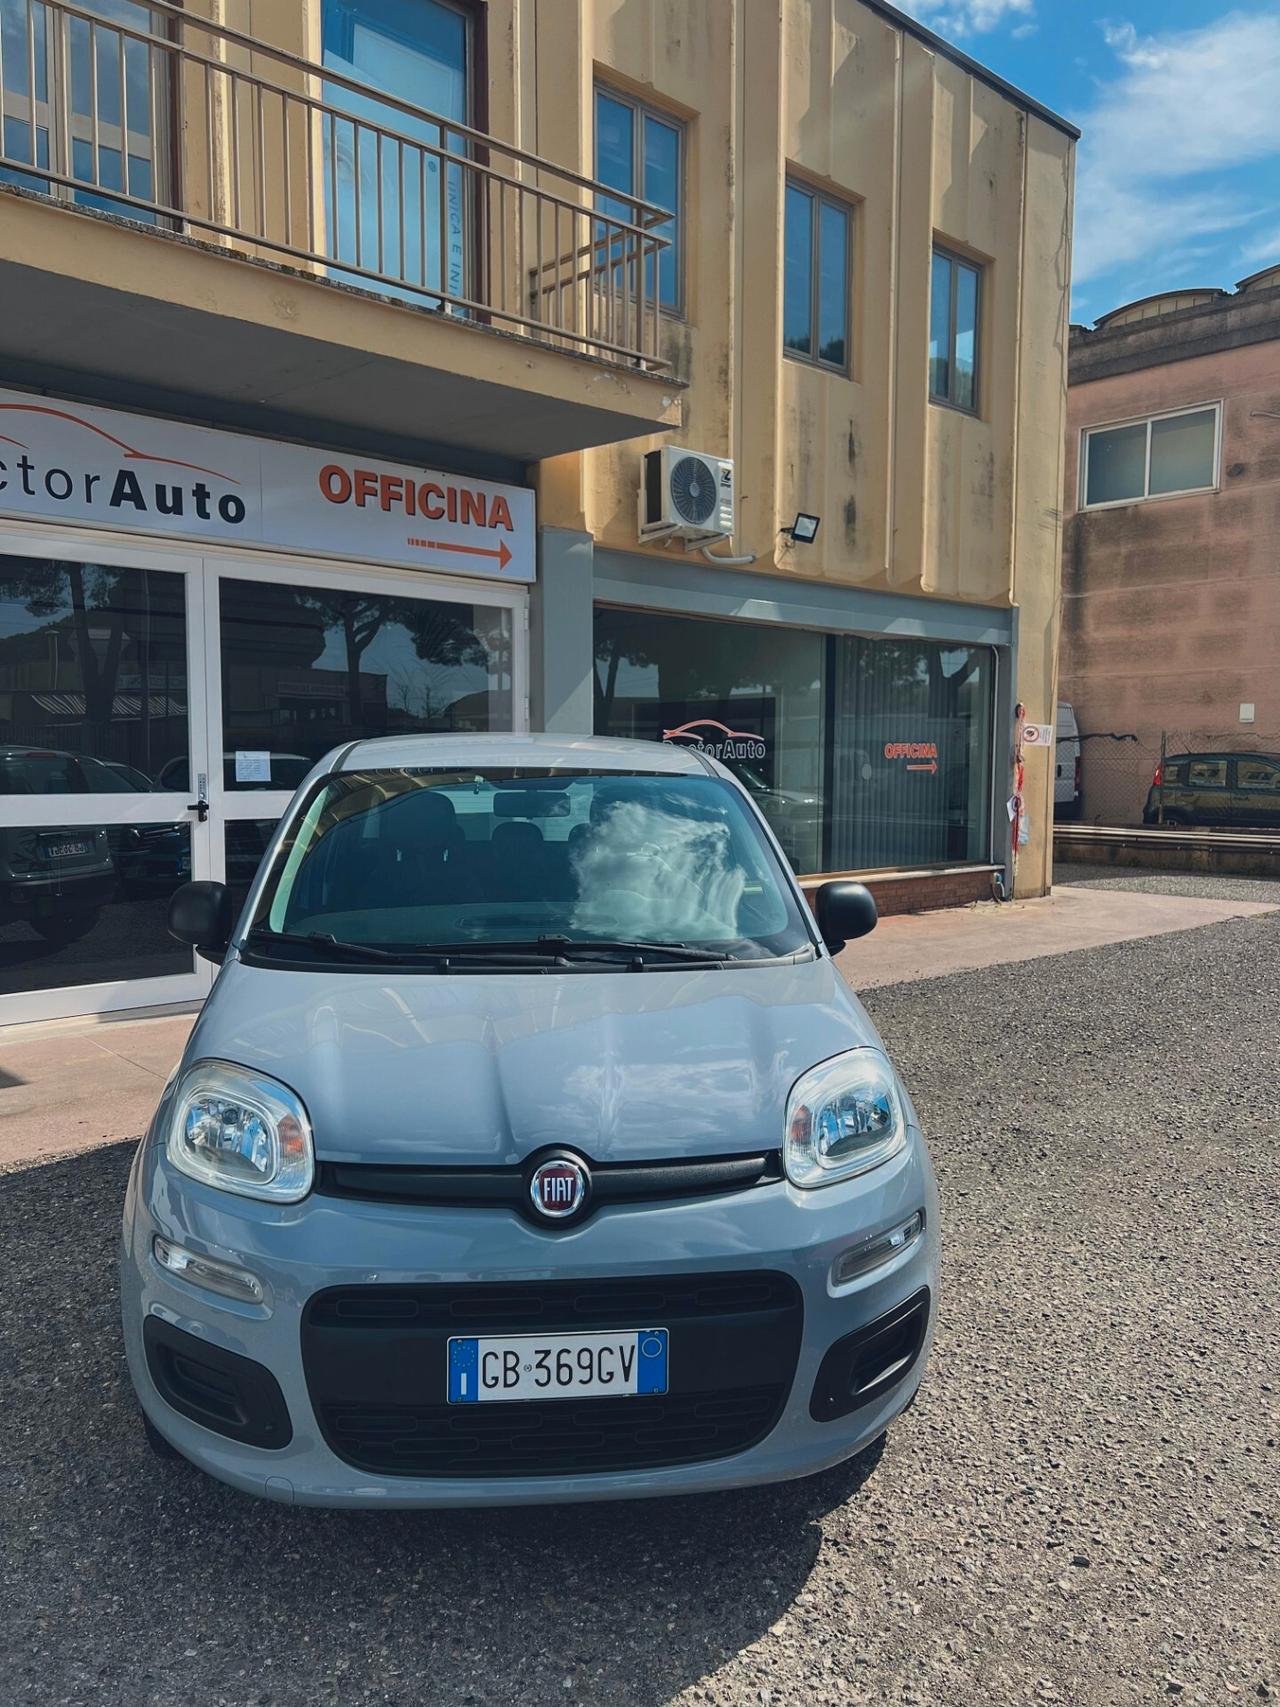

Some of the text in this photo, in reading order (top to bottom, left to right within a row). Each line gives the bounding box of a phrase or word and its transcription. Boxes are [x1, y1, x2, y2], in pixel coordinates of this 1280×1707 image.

[319, 464, 514, 532] OFFICINA
[884, 743, 938, 759] OFFICINA
[543, 1177, 575, 1202] FIAT
